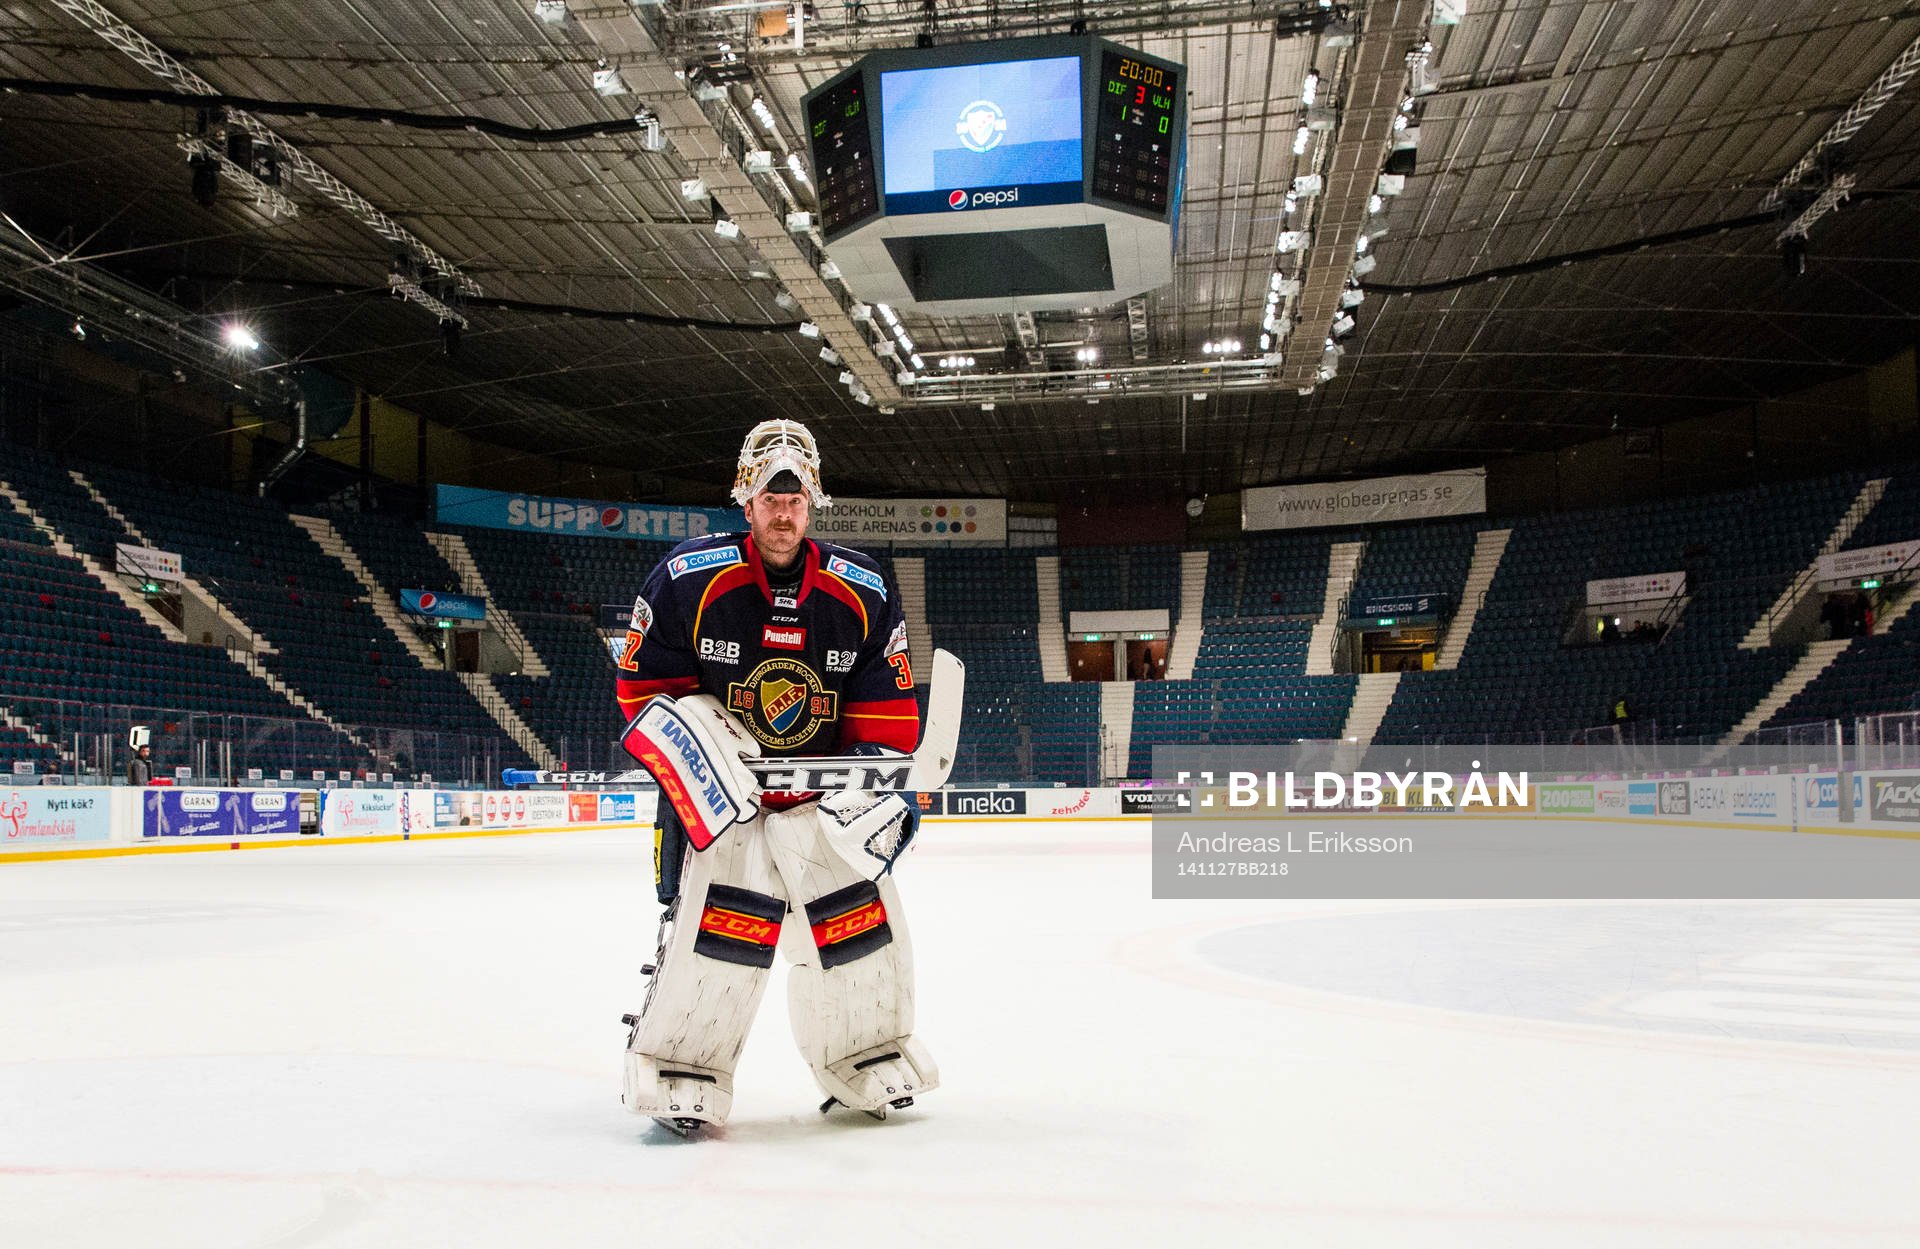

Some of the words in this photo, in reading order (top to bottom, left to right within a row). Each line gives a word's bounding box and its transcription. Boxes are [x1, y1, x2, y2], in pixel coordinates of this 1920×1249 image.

[1119, 58, 1164, 88] 20:00
[1107, 80, 1127, 95] DIF
[1134, 85, 1146, 104] 3
[1152, 94, 1171, 110] VLH
[1158, 115, 1169, 134] 0
[972, 187, 1018, 207] pepsi
[1278, 484, 1453, 513] www.globearenas.se
[815, 520, 857, 532] GLOBE
[862, 521, 916, 533] ARENAS
[689, 551, 736, 566] CORVARA
[1365, 603, 1413, 614] ERICSSON
[771, 615, 798, 623] CCM
[700, 637, 740, 659] B2B
[700, 655, 739, 665] IT-PARTNER
[749, 662, 795, 689] DJURGÅRDEN
[795, 666, 820, 694] HOCKEY
[733, 689, 755, 709] 18
[810, 696, 831, 715] 91
[745, 712, 785, 745] STOCKHOLMS
[785, 716, 818, 745] STOLTHET
[551, 772, 606, 783] CCM
[754, 766, 912, 790] CCM
[641, 753, 697, 828] CCM
[47, 799, 68, 811] Nytt
[71, 798, 94, 809] kök?
[183, 796, 216, 806] GARANT
[254, 797, 283, 806] GARANT
[957, 792, 1015, 813] ineko
[1051, 790, 1091, 815] zehnder
[704, 911, 771, 938] CCM
[826, 907, 882, 939] CCM
